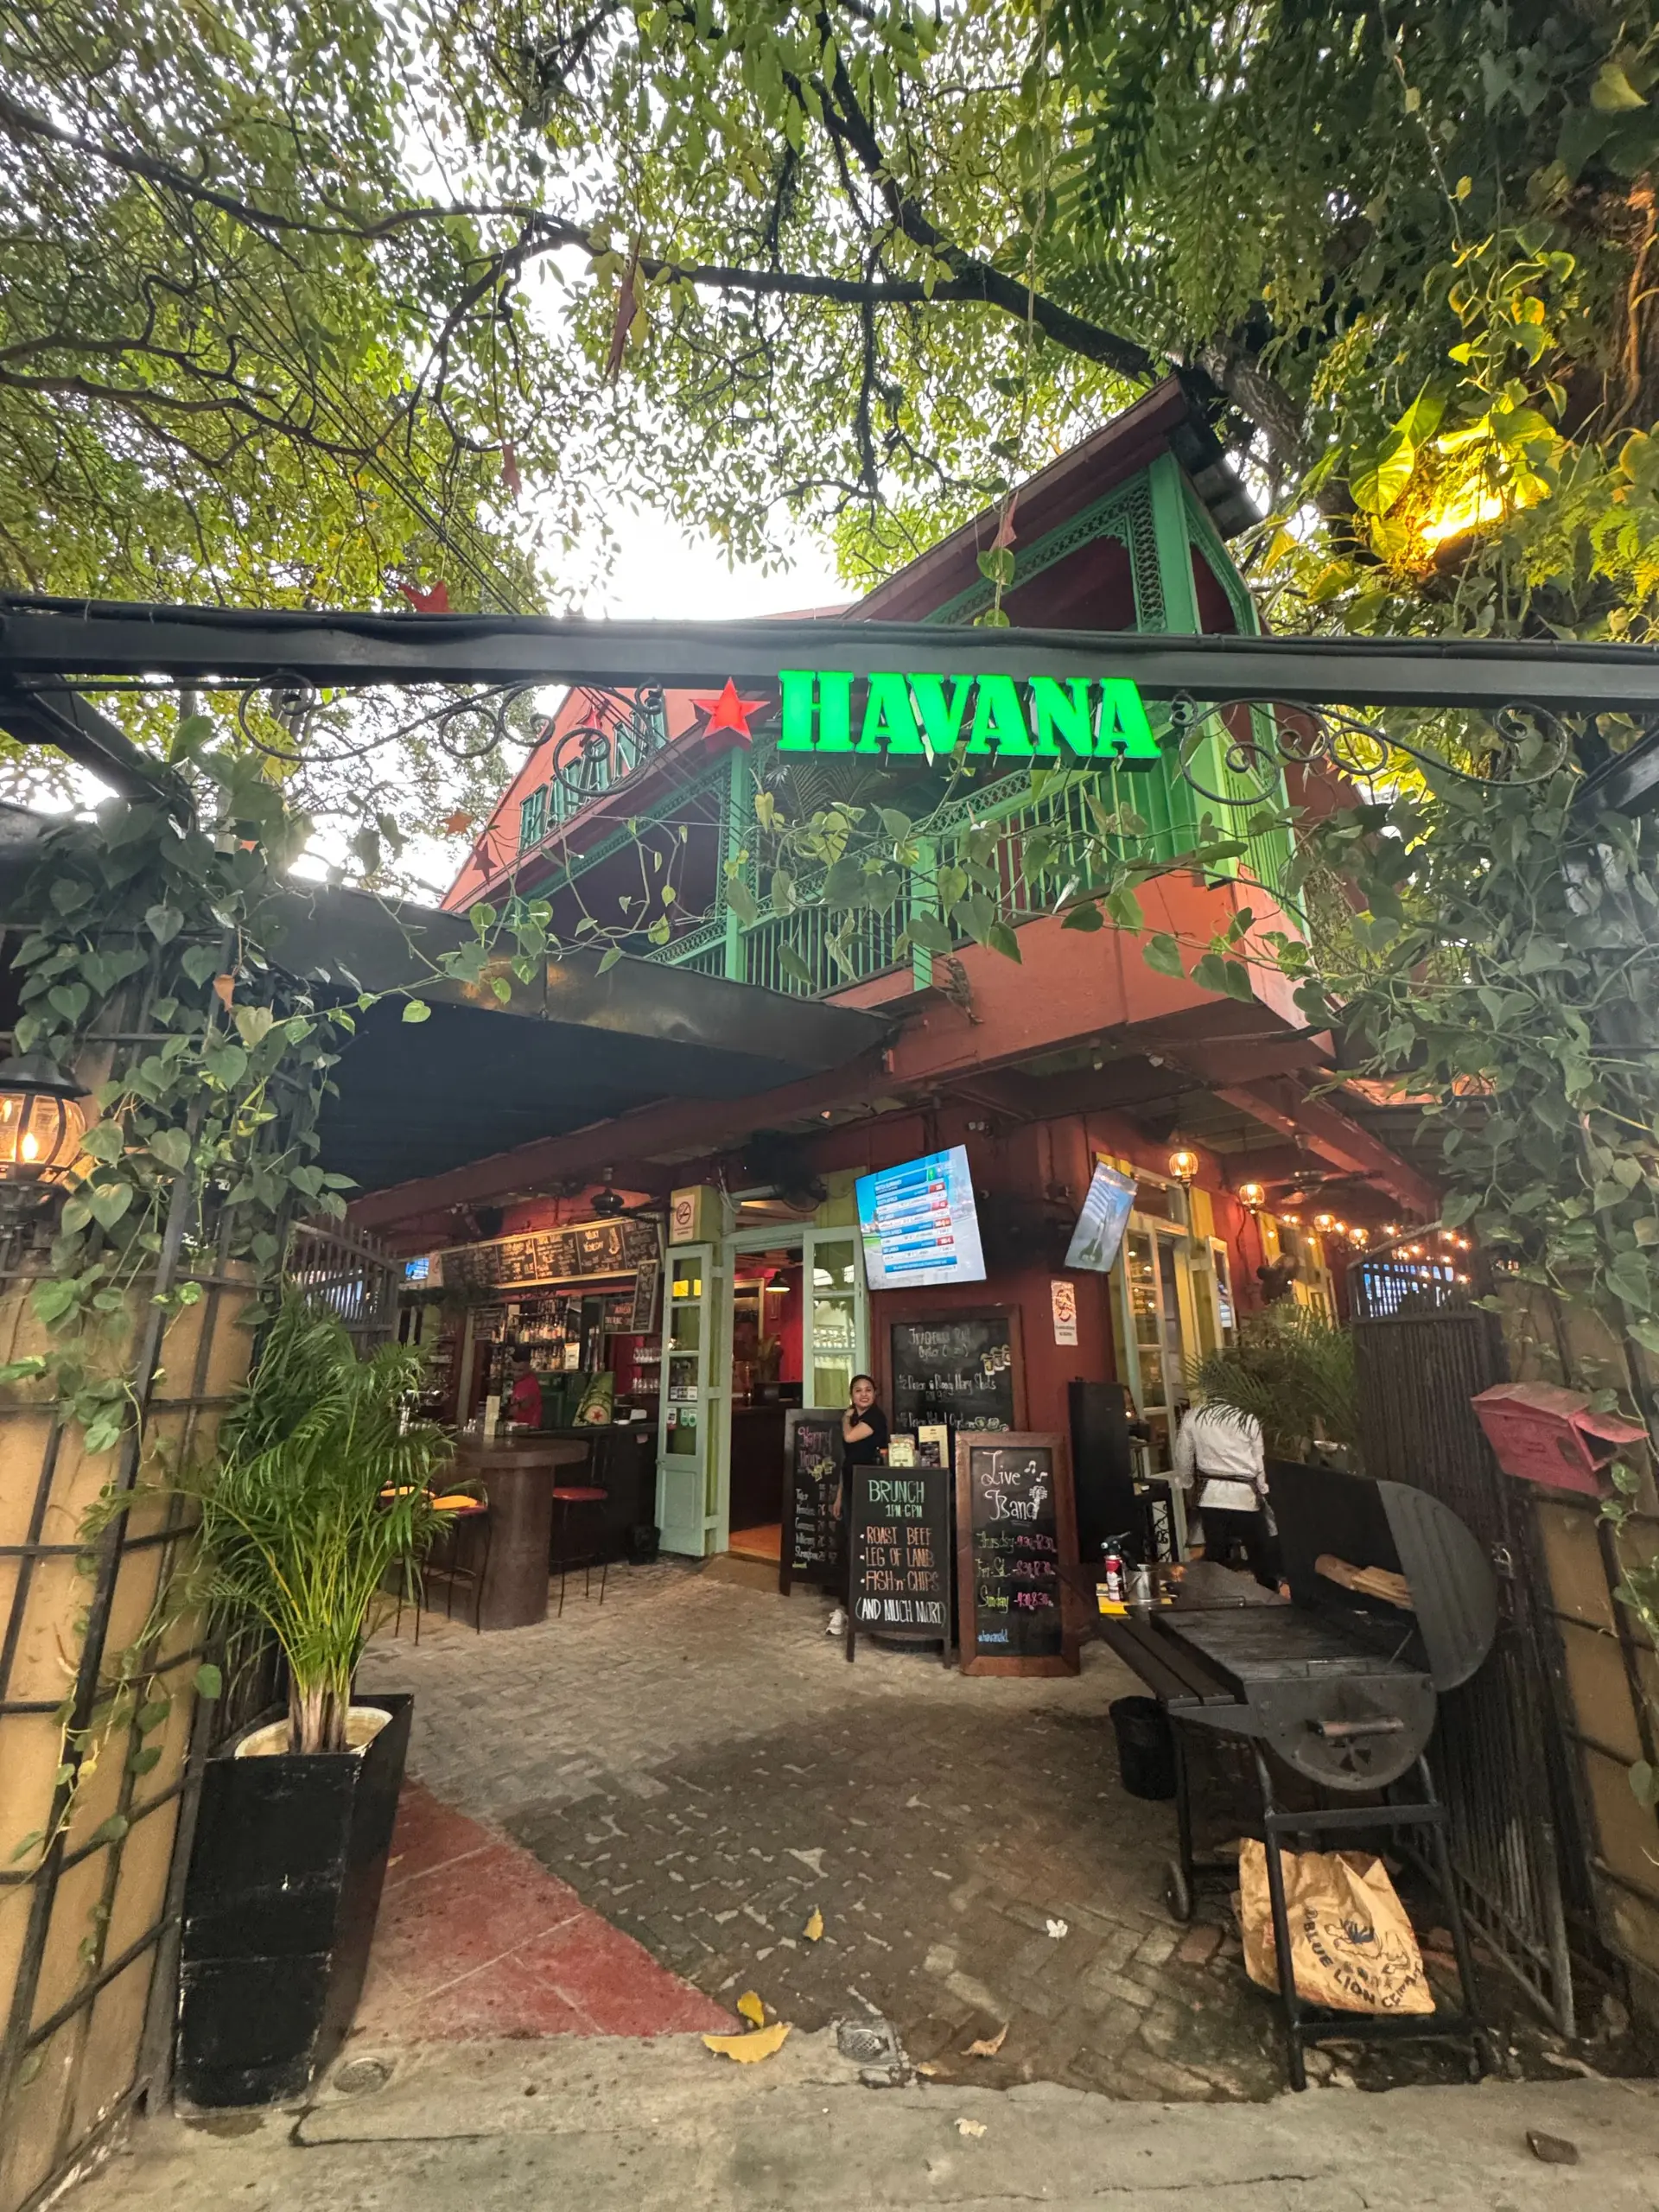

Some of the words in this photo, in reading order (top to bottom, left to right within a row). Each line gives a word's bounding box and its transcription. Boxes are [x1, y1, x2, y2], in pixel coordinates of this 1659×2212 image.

[778, 670, 1161, 758] HAVANA
[981, 1450, 1020, 1487] Live
[868, 1479, 925, 1503] BRUNCH
[984, 1489, 1039, 1521] Band
[867, 1526, 897, 1545] ROAST
[906, 1527, 932, 1546] BEEF
[865, 1547, 886, 1567] LEG
[889, 1548, 902, 1567] OF
[906, 1548, 935, 1568] LAMB
[866, 1570, 893, 1591] FISH
[907, 1571, 940, 1592] CHIPS
[884, 1599, 913, 1623] MUCH
[977, 1585, 1009, 1613] Sunday
[1304, 1920, 1334, 1968] BLUE
[1333, 1968, 1376, 2005] LION
